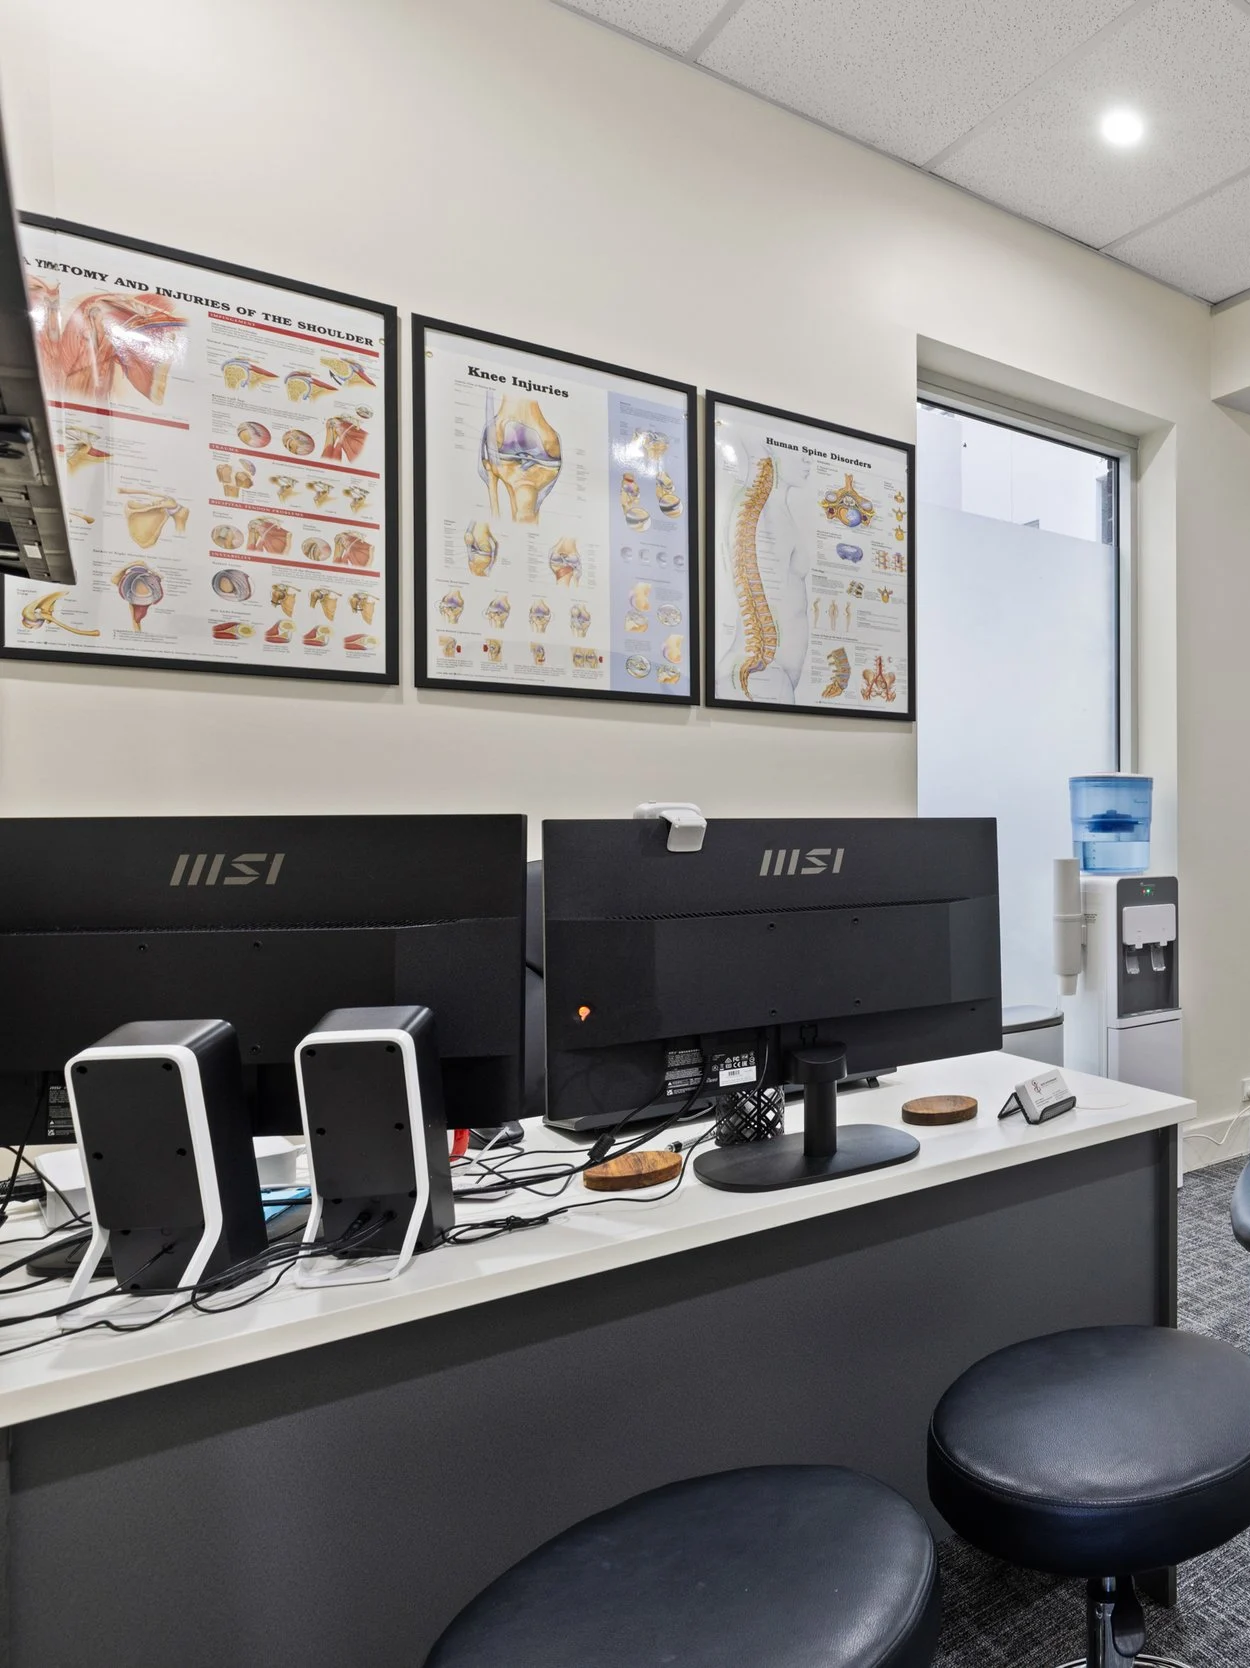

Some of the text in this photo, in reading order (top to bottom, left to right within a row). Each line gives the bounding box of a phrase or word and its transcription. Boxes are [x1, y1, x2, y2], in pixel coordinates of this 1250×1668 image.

[114, 277, 149, 292] AND
[155, 286, 230, 311] INJURIES
[236, 306, 256, 317] OF
[262, 312, 292, 326] THE
[297, 321, 374, 347] SHOULDER
[467, 366, 507, 384] Knee
[512, 376, 569, 398] Injuries
[766, 437, 799, 452] Human
[802, 446, 828, 459] Spine
[830, 453, 872, 469] Disorders
